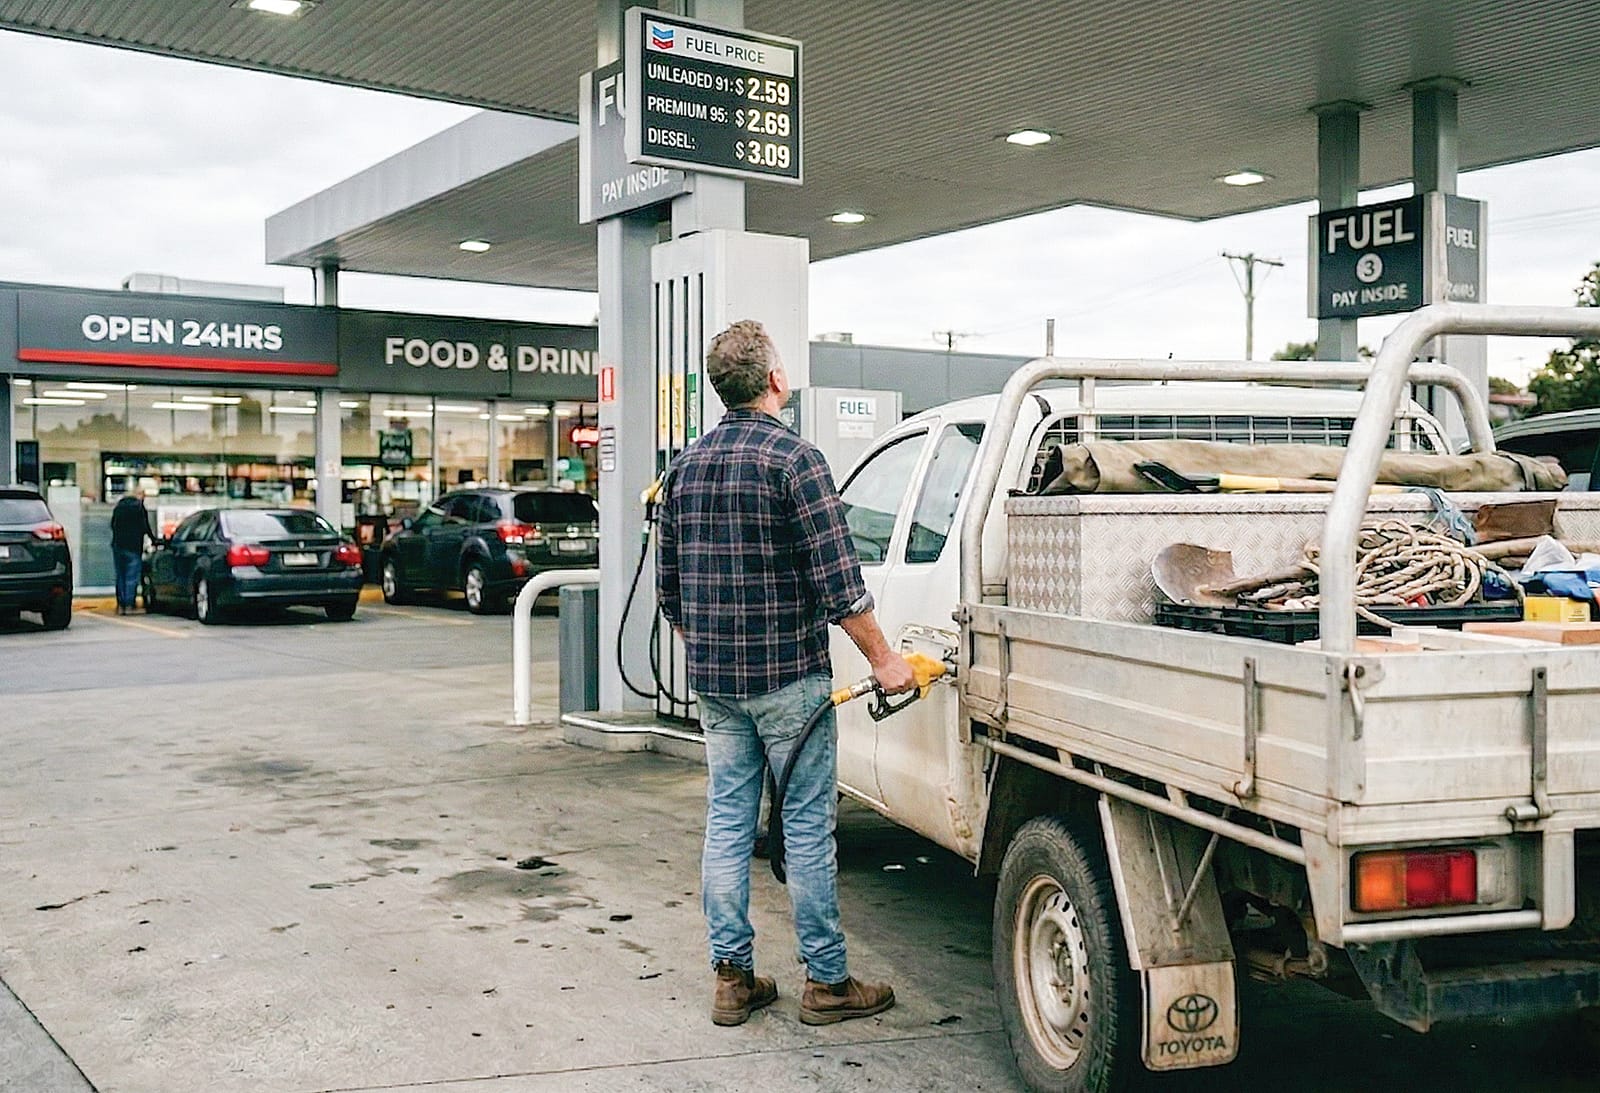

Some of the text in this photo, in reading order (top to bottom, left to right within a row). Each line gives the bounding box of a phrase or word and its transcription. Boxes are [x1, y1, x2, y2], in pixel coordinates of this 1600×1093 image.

[686, 37, 766, 64] FUEL PRICE
[648, 63, 713, 89] UNLEADED
[648, 96, 707, 120] PREMIUM
[710, 107, 729, 124] 95:
[648, 128, 696, 150] DIESEL:
[601, 167, 670, 204] PAY INSIDE
[1327, 207, 1415, 254] FUEL
[1446, 225, 1477, 249] FUEL
[1364, 260, 1375, 277] 3
[1332, 283, 1409, 308] PAY INSIDE
[81, 314, 283, 352] OPEN 24HRS
[385, 337, 480, 370] FOOD
[487, 344, 508, 370] &
[840, 401, 873, 415] FUEL
[1158, 1036, 1227, 1056] TOYOTA
